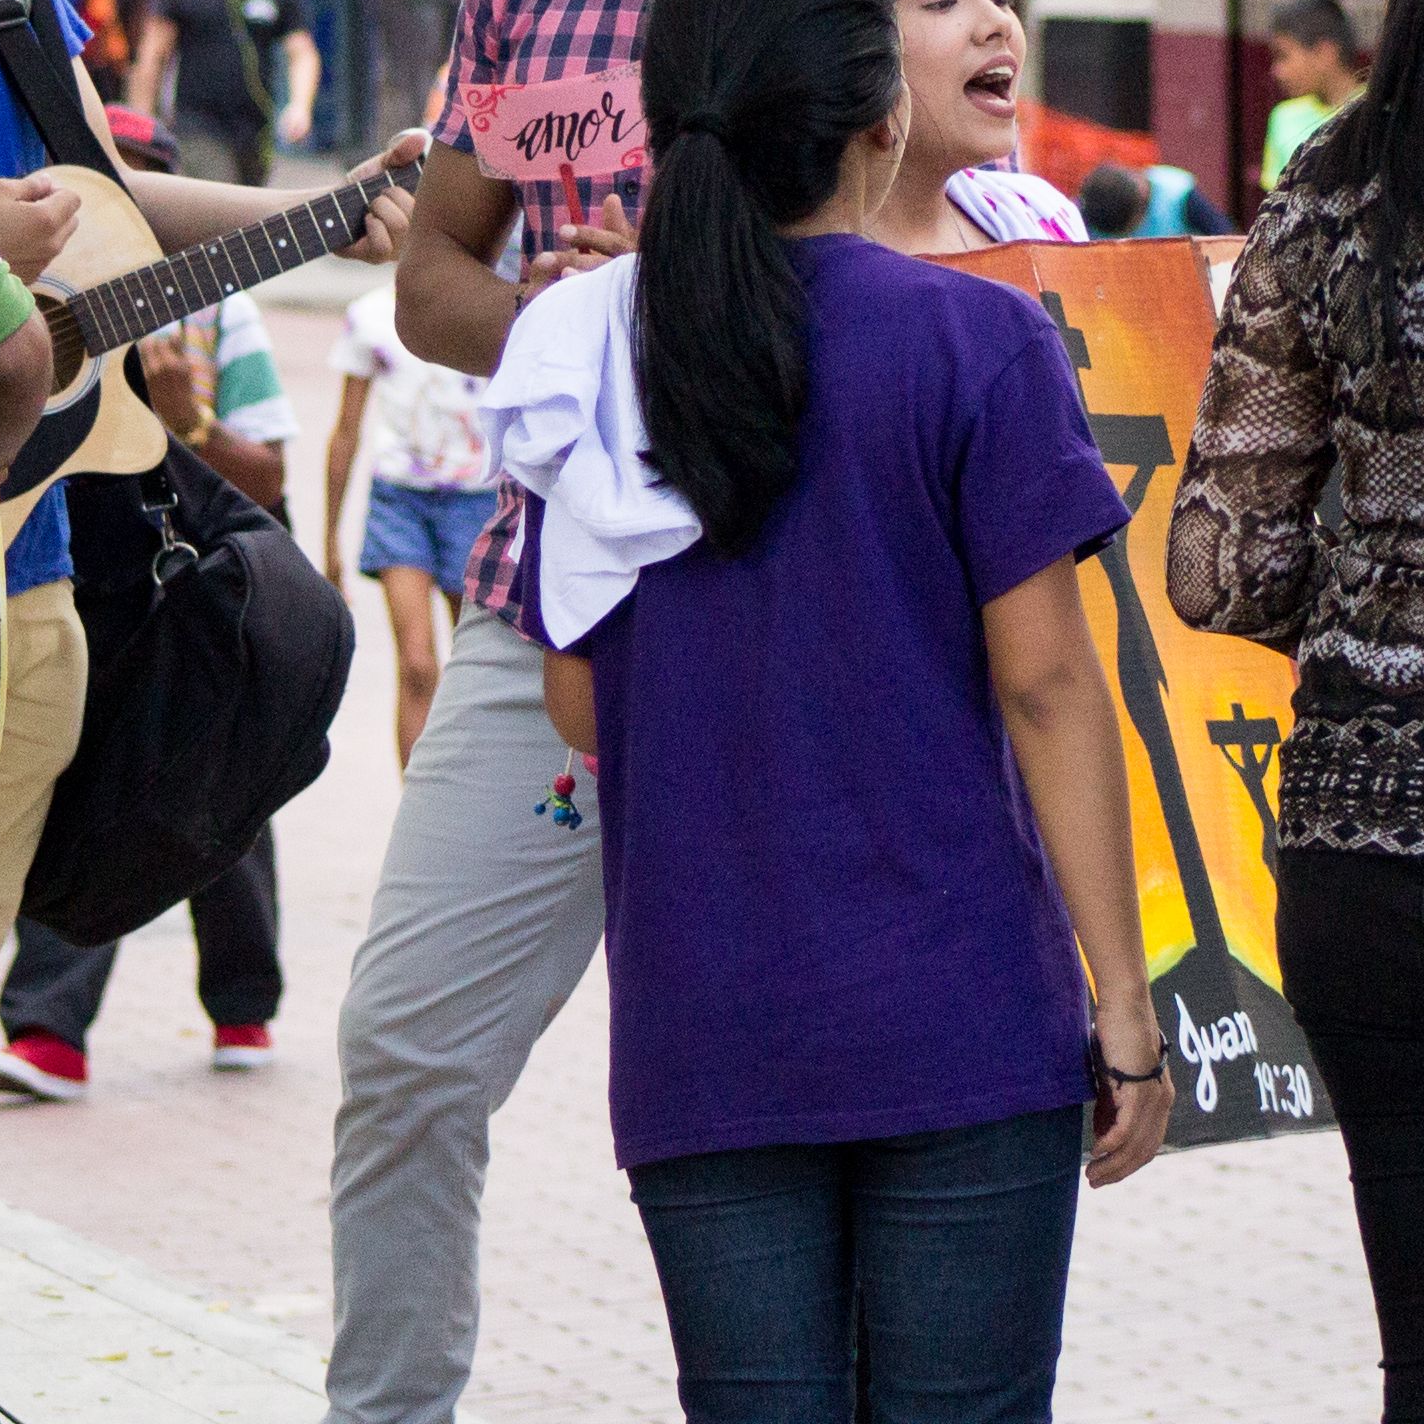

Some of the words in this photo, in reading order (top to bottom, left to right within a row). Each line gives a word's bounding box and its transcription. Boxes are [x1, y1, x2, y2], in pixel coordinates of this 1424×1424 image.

[503, 91, 646, 161] amor
[1174, 992, 1258, 1113] Juan
[1253, 1061, 1314, 1119] 19:30
